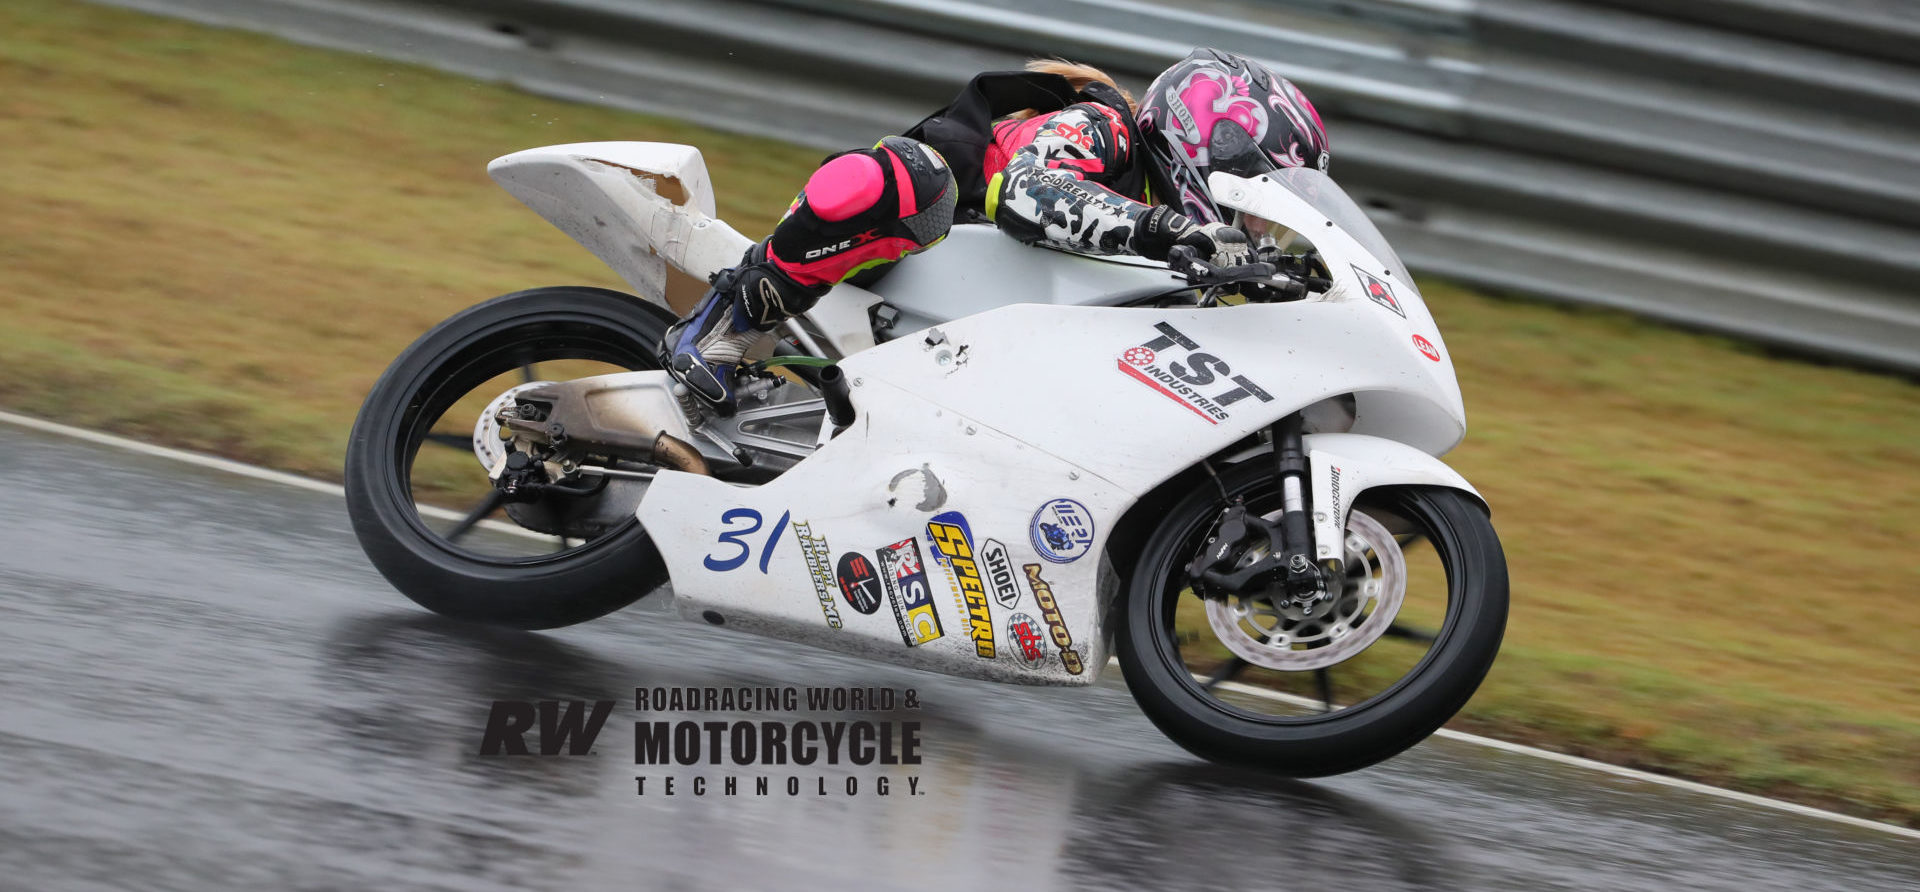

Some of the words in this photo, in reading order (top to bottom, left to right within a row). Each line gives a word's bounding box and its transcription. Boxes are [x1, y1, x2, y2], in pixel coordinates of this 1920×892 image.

[1168, 92, 1196, 133] SHOEI
[1062, 183, 1112, 210] REALTY
[1140, 321, 1275, 408] TST
[1144, 364, 1229, 421] INDUSTRIES
[703, 508, 790, 574] 31
[811, 538, 835, 585] HAPPY
[886, 563, 898, 590] RISING
[896, 594, 904, 610] SUN
[903, 614, 915, 642] CYCLES
[927, 523, 994, 657] SPECTRO
[984, 547, 1016, 604] SHOEI
[1013, 622, 1042, 662] sbs
[1022, 563, 1083, 677] MOTO-D
